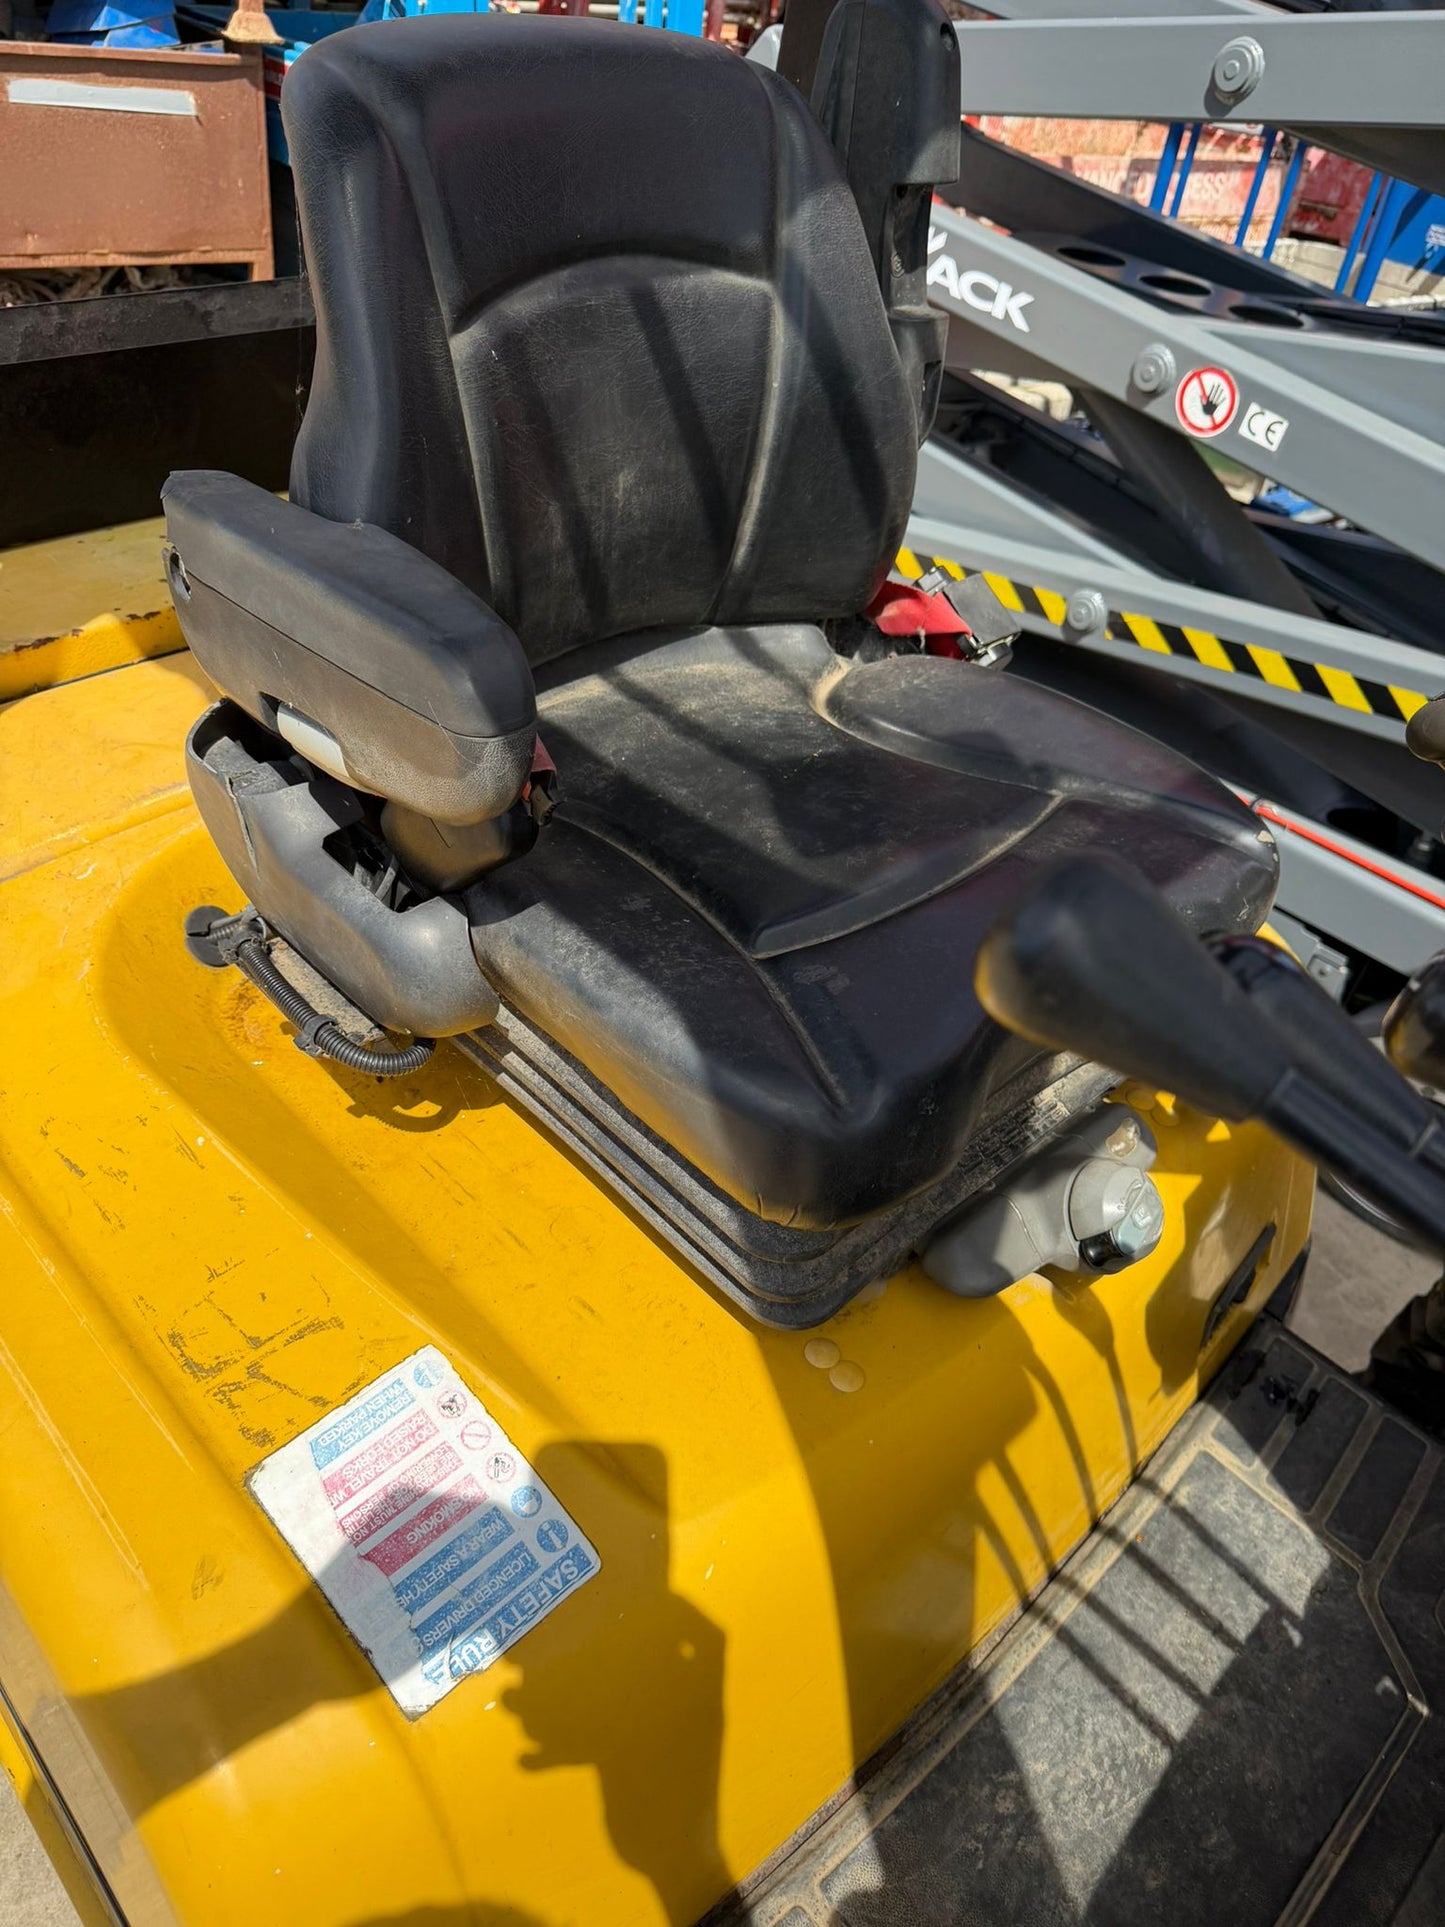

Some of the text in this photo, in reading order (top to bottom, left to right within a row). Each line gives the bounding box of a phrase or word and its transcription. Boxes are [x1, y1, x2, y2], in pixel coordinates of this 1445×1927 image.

[1247, 411, 1284, 446] CE
[316, 1381, 403, 1448] WHEN PARKED
[334, 1392, 411, 1452] REMOVE KEY
[412, 1422, 434, 1442] DO
[340, 1412, 426, 1479] RAISED FORKS
[389, 1437, 415, 1459] NOT
[436, 1450, 453, 1466] BE
[343, 1455, 390, 1495] TRAVEL
[383, 1480, 400, 1495] OF
[391, 1479, 415, 1500] FOR
[394, 1471, 438, 1509] MACHINE
[339, 1490, 386, 1529] PERSONS
[367, 1503, 397, 1530] MUST
[371, 1496, 393, 1515] THE
[403, 1481, 482, 1545] NO SMOKING
[454, 1544, 470, 1560] A
[466, 1517, 504, 1551] WEAR
[410, 1552, 460, 1597] SAFETY
[420, 1550, 531, 1647] LICENCED DRIVERS
[490, 1556, 582, 1638] SAFETY
